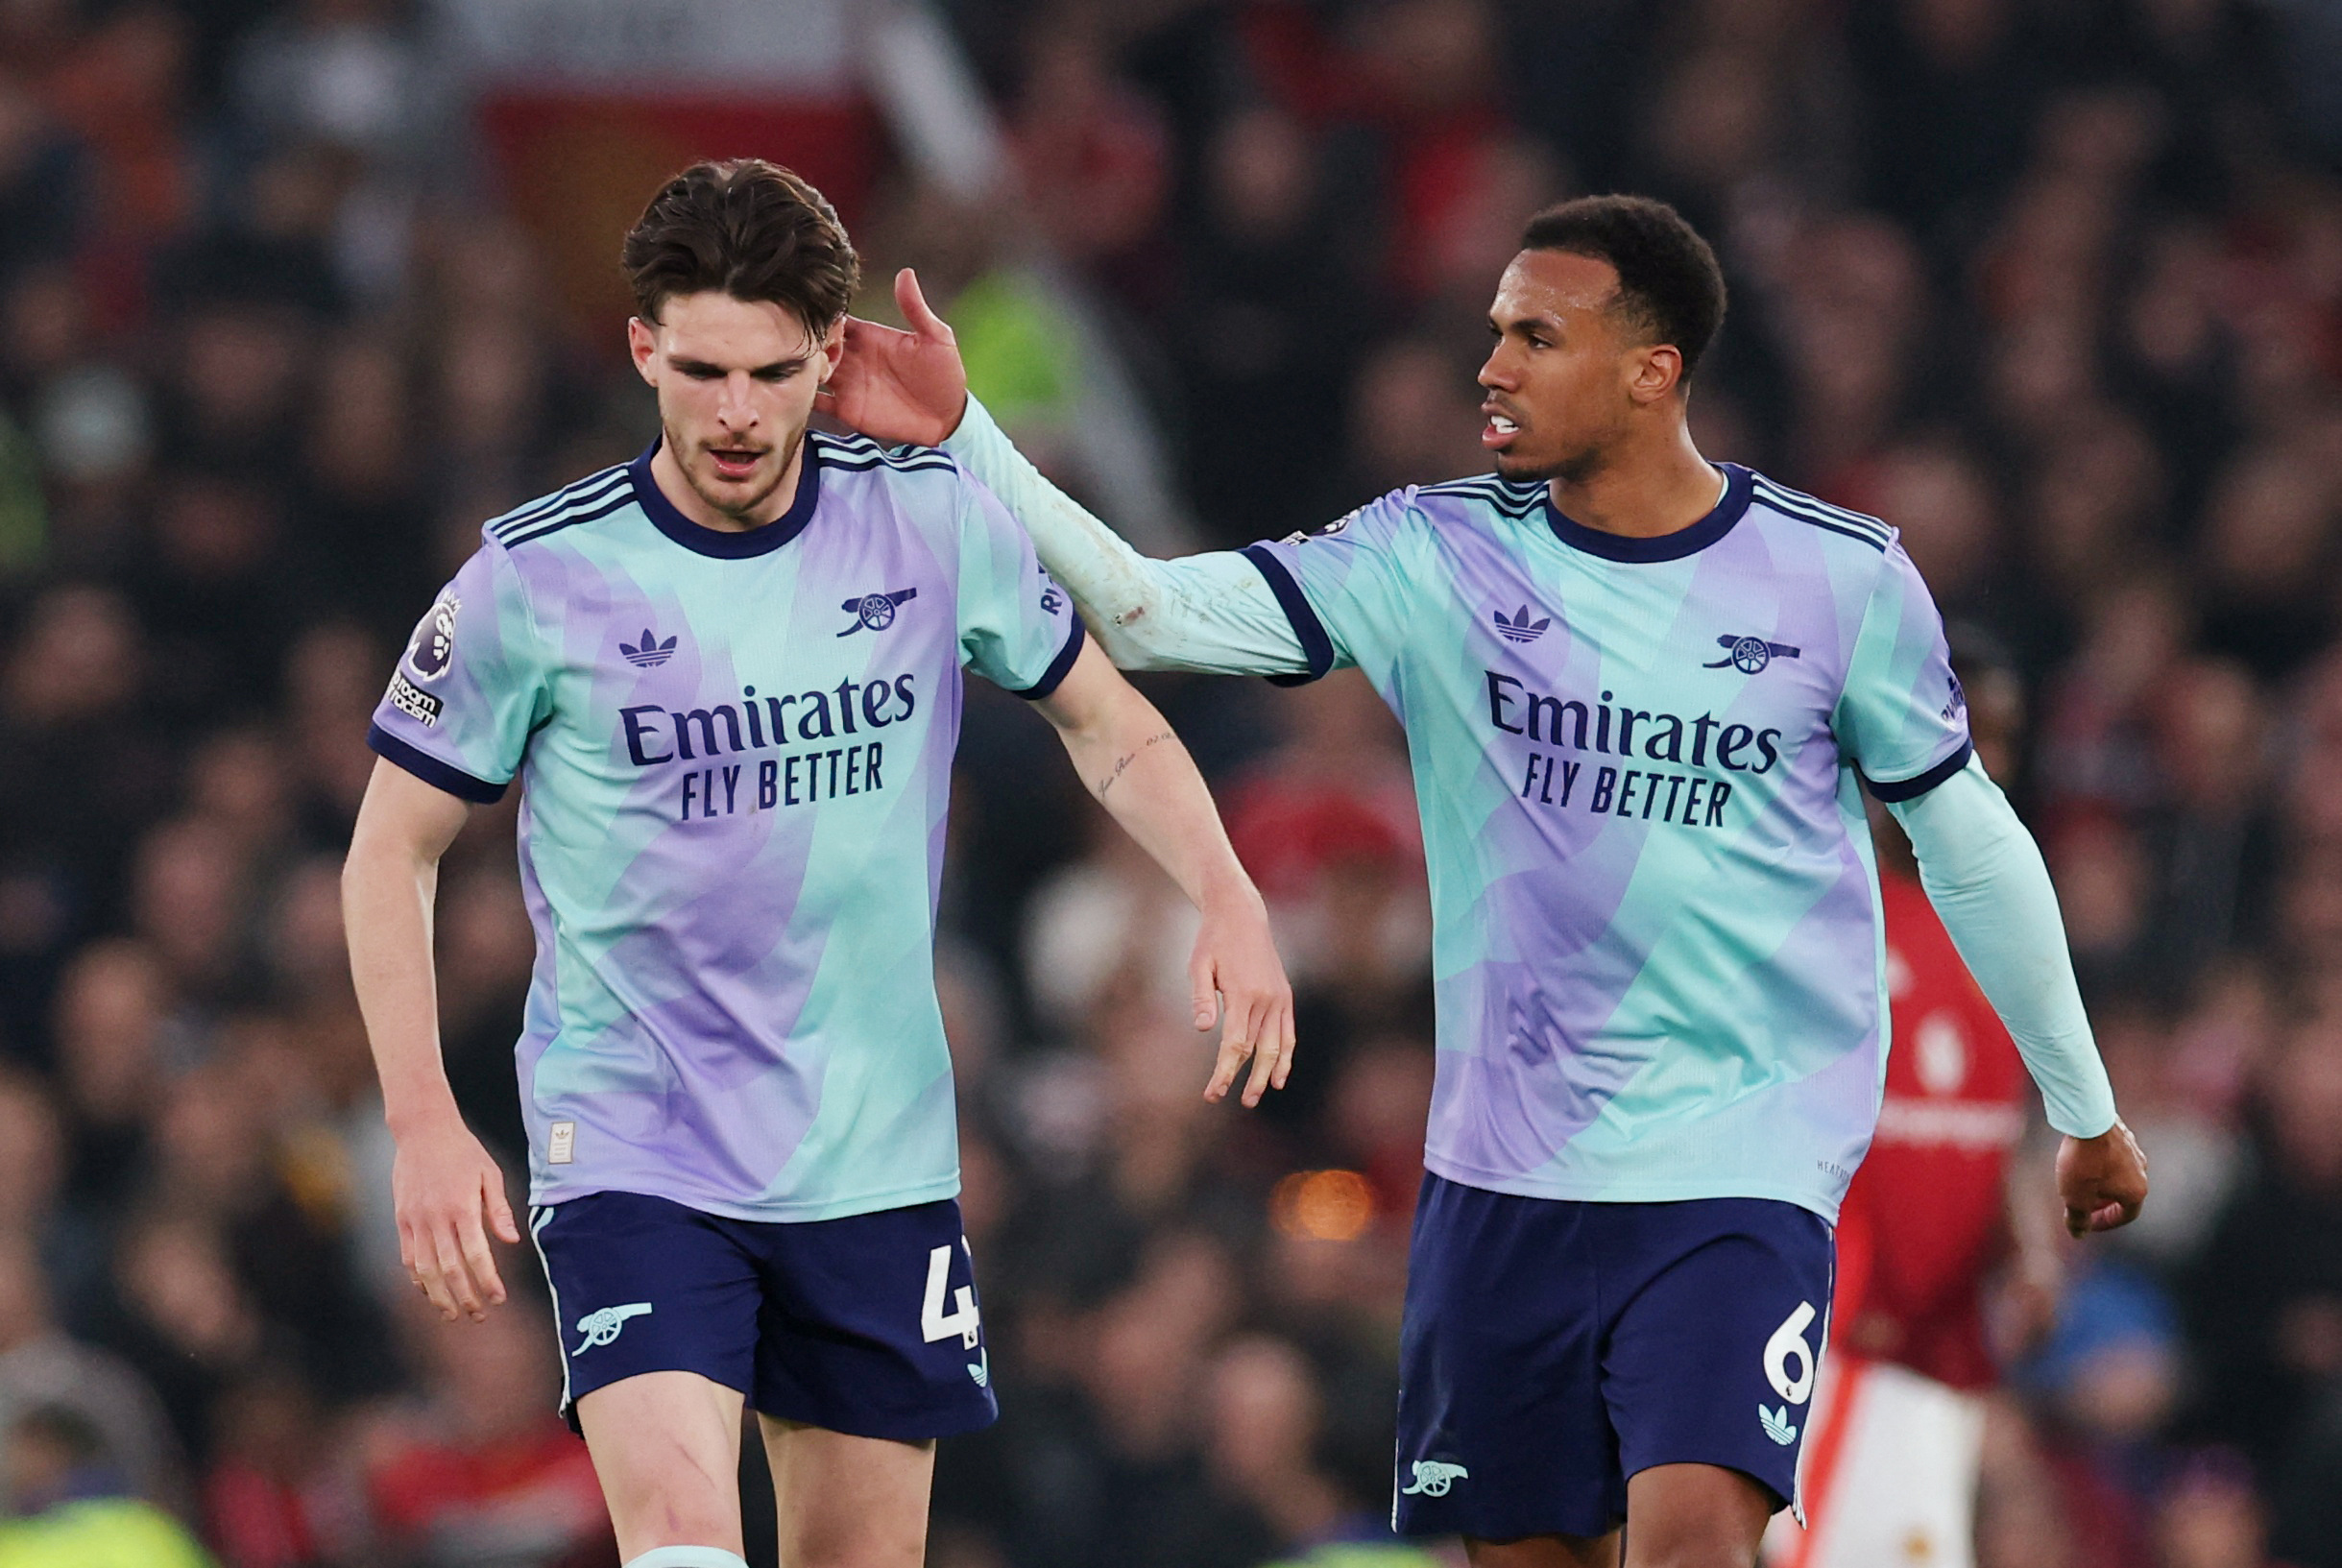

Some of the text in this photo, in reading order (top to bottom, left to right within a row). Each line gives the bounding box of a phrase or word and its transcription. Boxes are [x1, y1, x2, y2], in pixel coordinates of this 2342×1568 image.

[390, 689, 437, 729] racism
[397, 677, 436, 712] room
[617, 673, 915, 767] Emirates
[1484, 669, 1782, 775] Emirates
[682, 741, 883, 821] FLY BETTER
[1521, 752, 1732, 828] FLY BETTER
[921, 1235, 980, 1351] 4
[1763, 1300, 1817, 1405] 6
